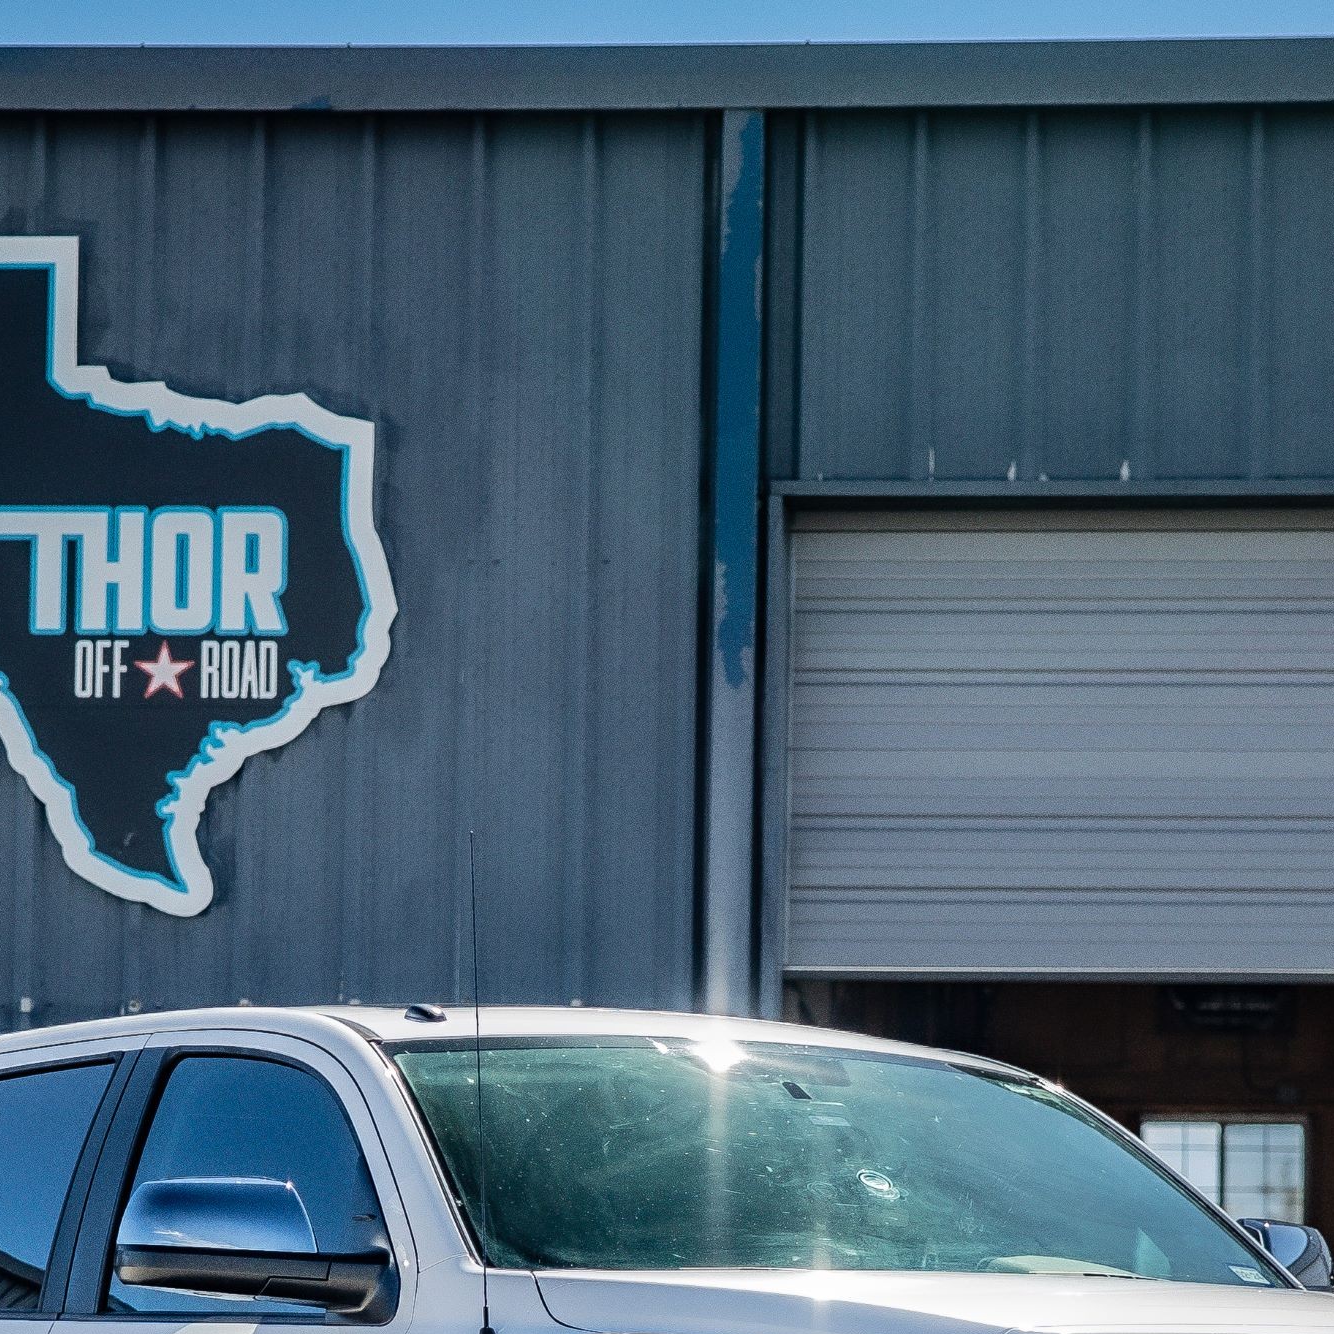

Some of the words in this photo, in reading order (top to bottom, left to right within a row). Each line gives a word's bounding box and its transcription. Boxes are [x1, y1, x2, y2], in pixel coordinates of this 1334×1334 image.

[29, 505, 288, 636] THOR
[74, 639, 129, 699] OFF
[200, 640, 278, 699] ROAD
